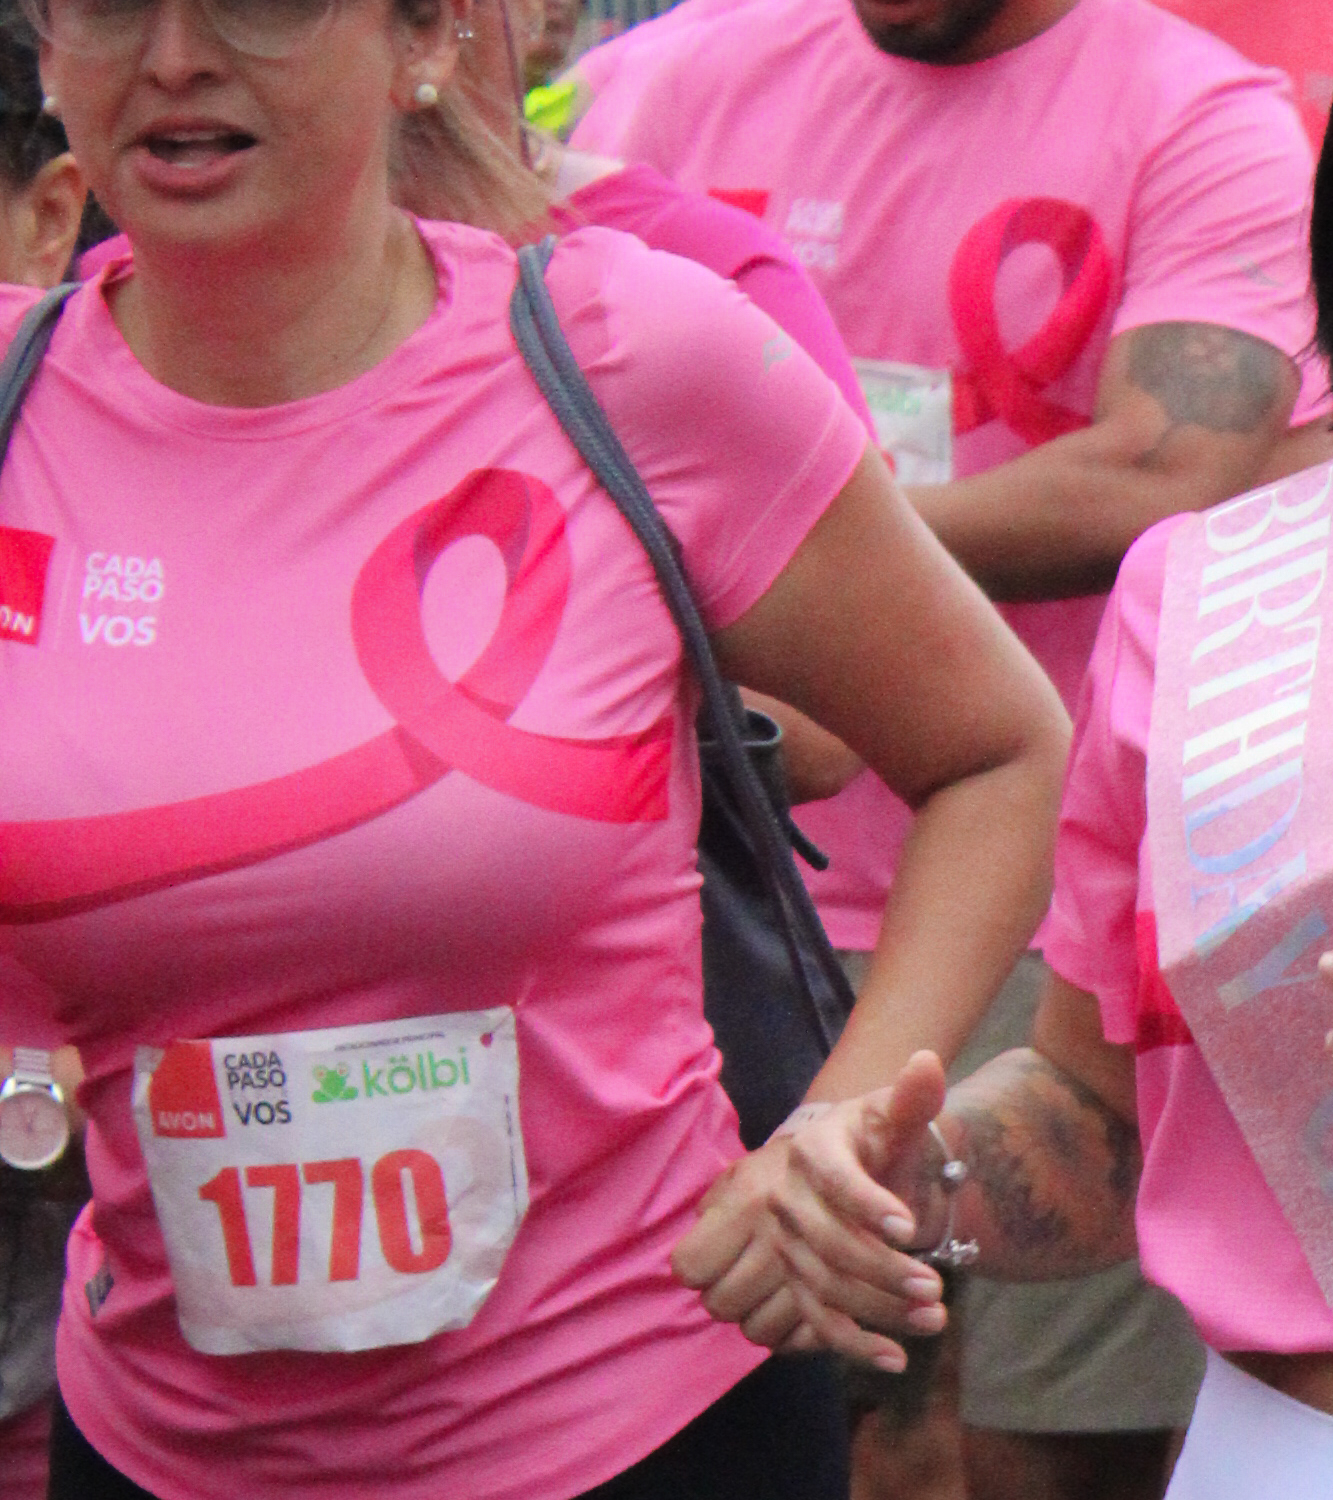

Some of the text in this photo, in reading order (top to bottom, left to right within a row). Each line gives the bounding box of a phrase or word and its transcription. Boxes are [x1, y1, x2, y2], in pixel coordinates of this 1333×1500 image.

[86, 552, 163, 579] CADA
[83, 575, 164, 602] PASO
[0, 605, 34, 636] ON
[79, 614, 156, 646] VOS
[224, 1051, 283, 1071] CADA
[362, 1046, 470, 1097] kölbi
[227, 1068, 287, 1091] PASO
[157, 1111, 216, 1131] AVON
[233, 1100, 292, 1127] VOS
[199, 1148, 453, 1287] 1770
